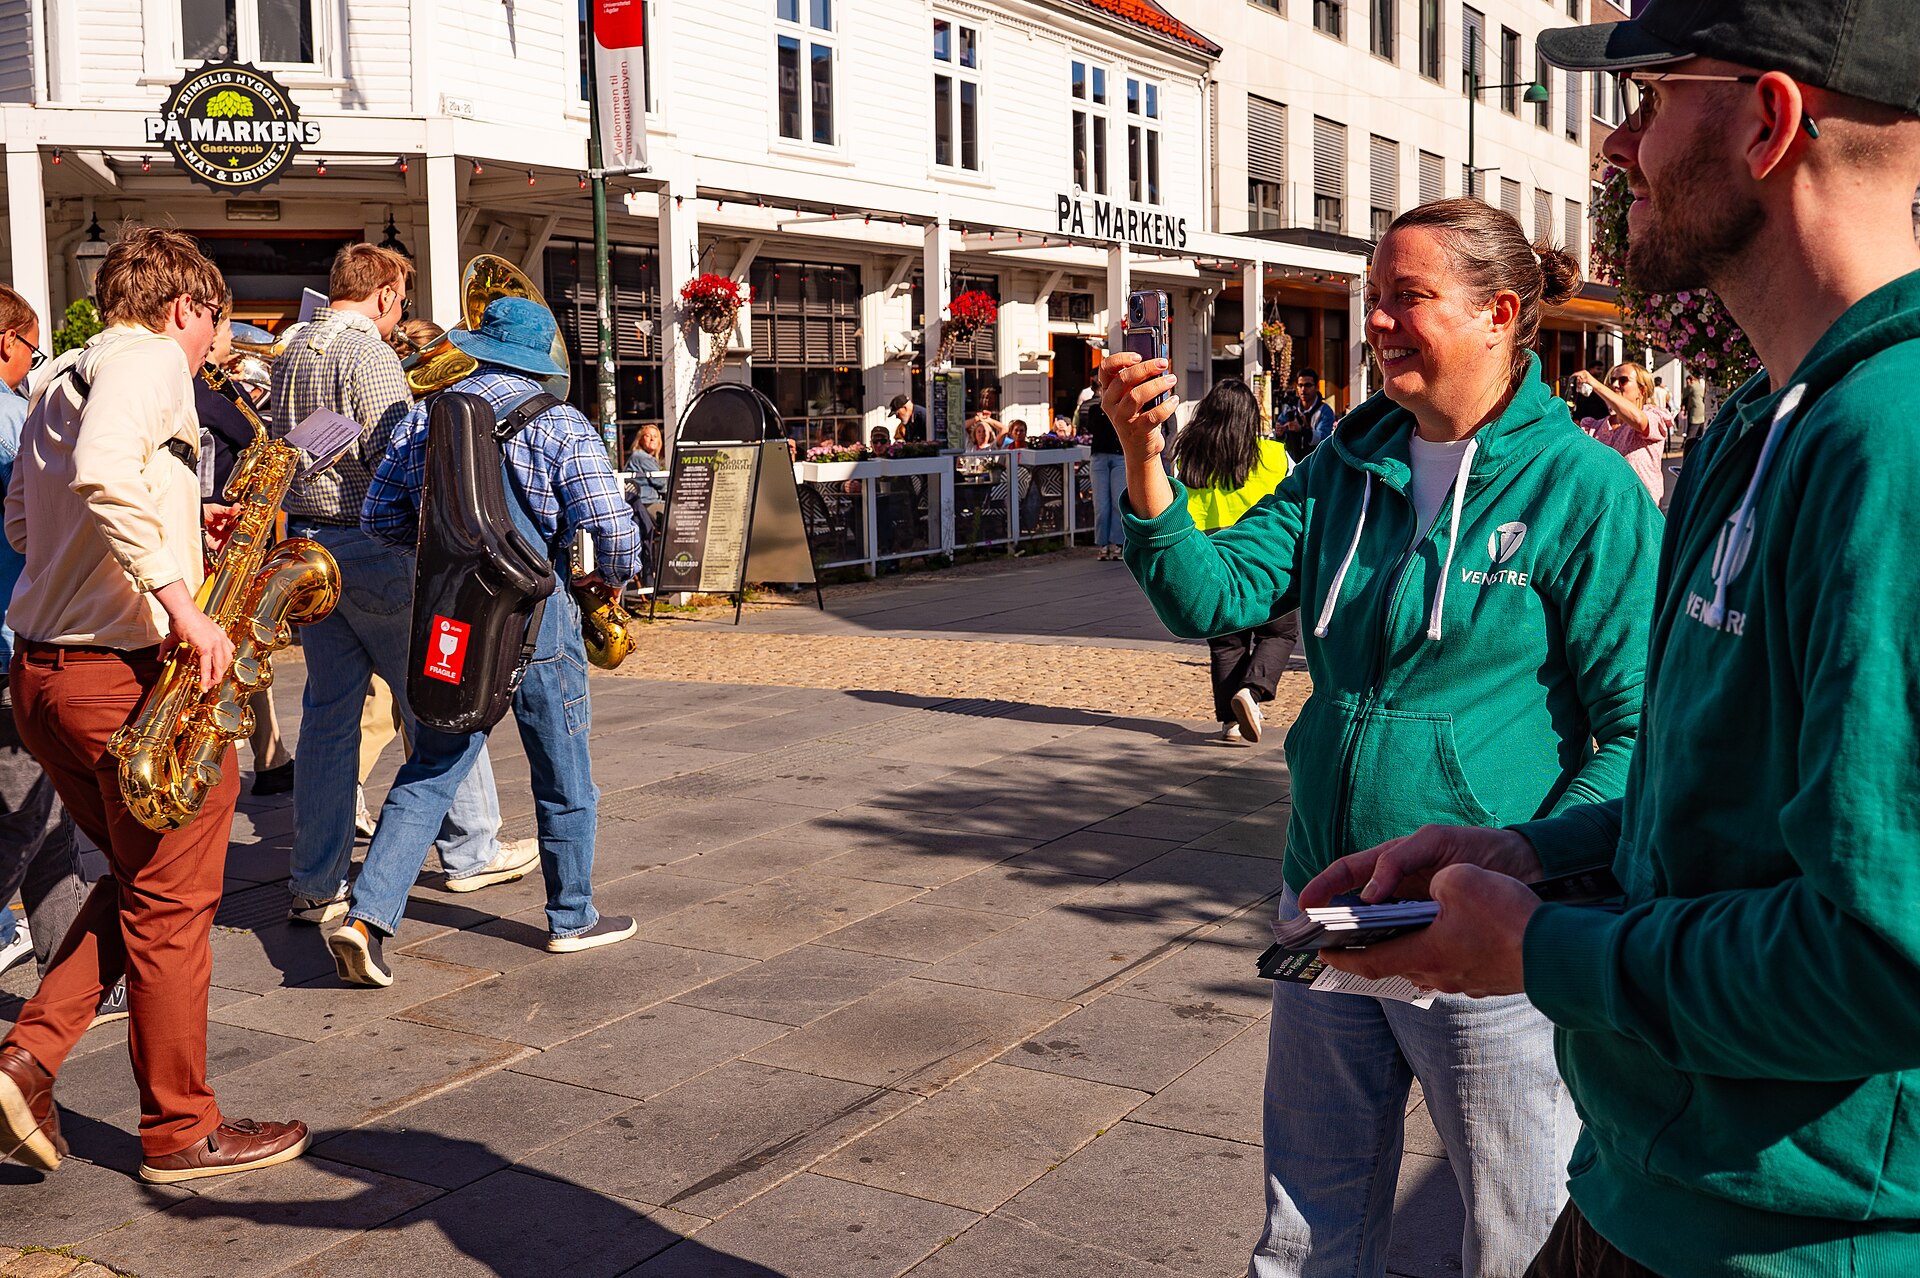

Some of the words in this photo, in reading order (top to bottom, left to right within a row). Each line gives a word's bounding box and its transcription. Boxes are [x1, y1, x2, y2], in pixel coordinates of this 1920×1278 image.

[181, 73, 232, 105] RIMELIG
[236, 75, 279, 106] HYGGE
[609, 75, 618, 86] til
[611, 88, 623, 157] Velkommen
[621, 61, 633, 155] universitetsbyen
[147, 112, 184, 142] PÅ
[190, 118, 321, 143] MARKENS
[200, 144, 264, 155] Gastropub
[186, 153, 215, 176] MAT
[216, 171, 227, 182] &
[232, 152, 282, 182] DRIKKE
[1058, 185, 1085, 235] PÅ
[1094, 200, 1187, 248] MARKENS
[1462, 567, 1529, 587] VENSTRE
[430, 666, 456, 678] FRAGILE
